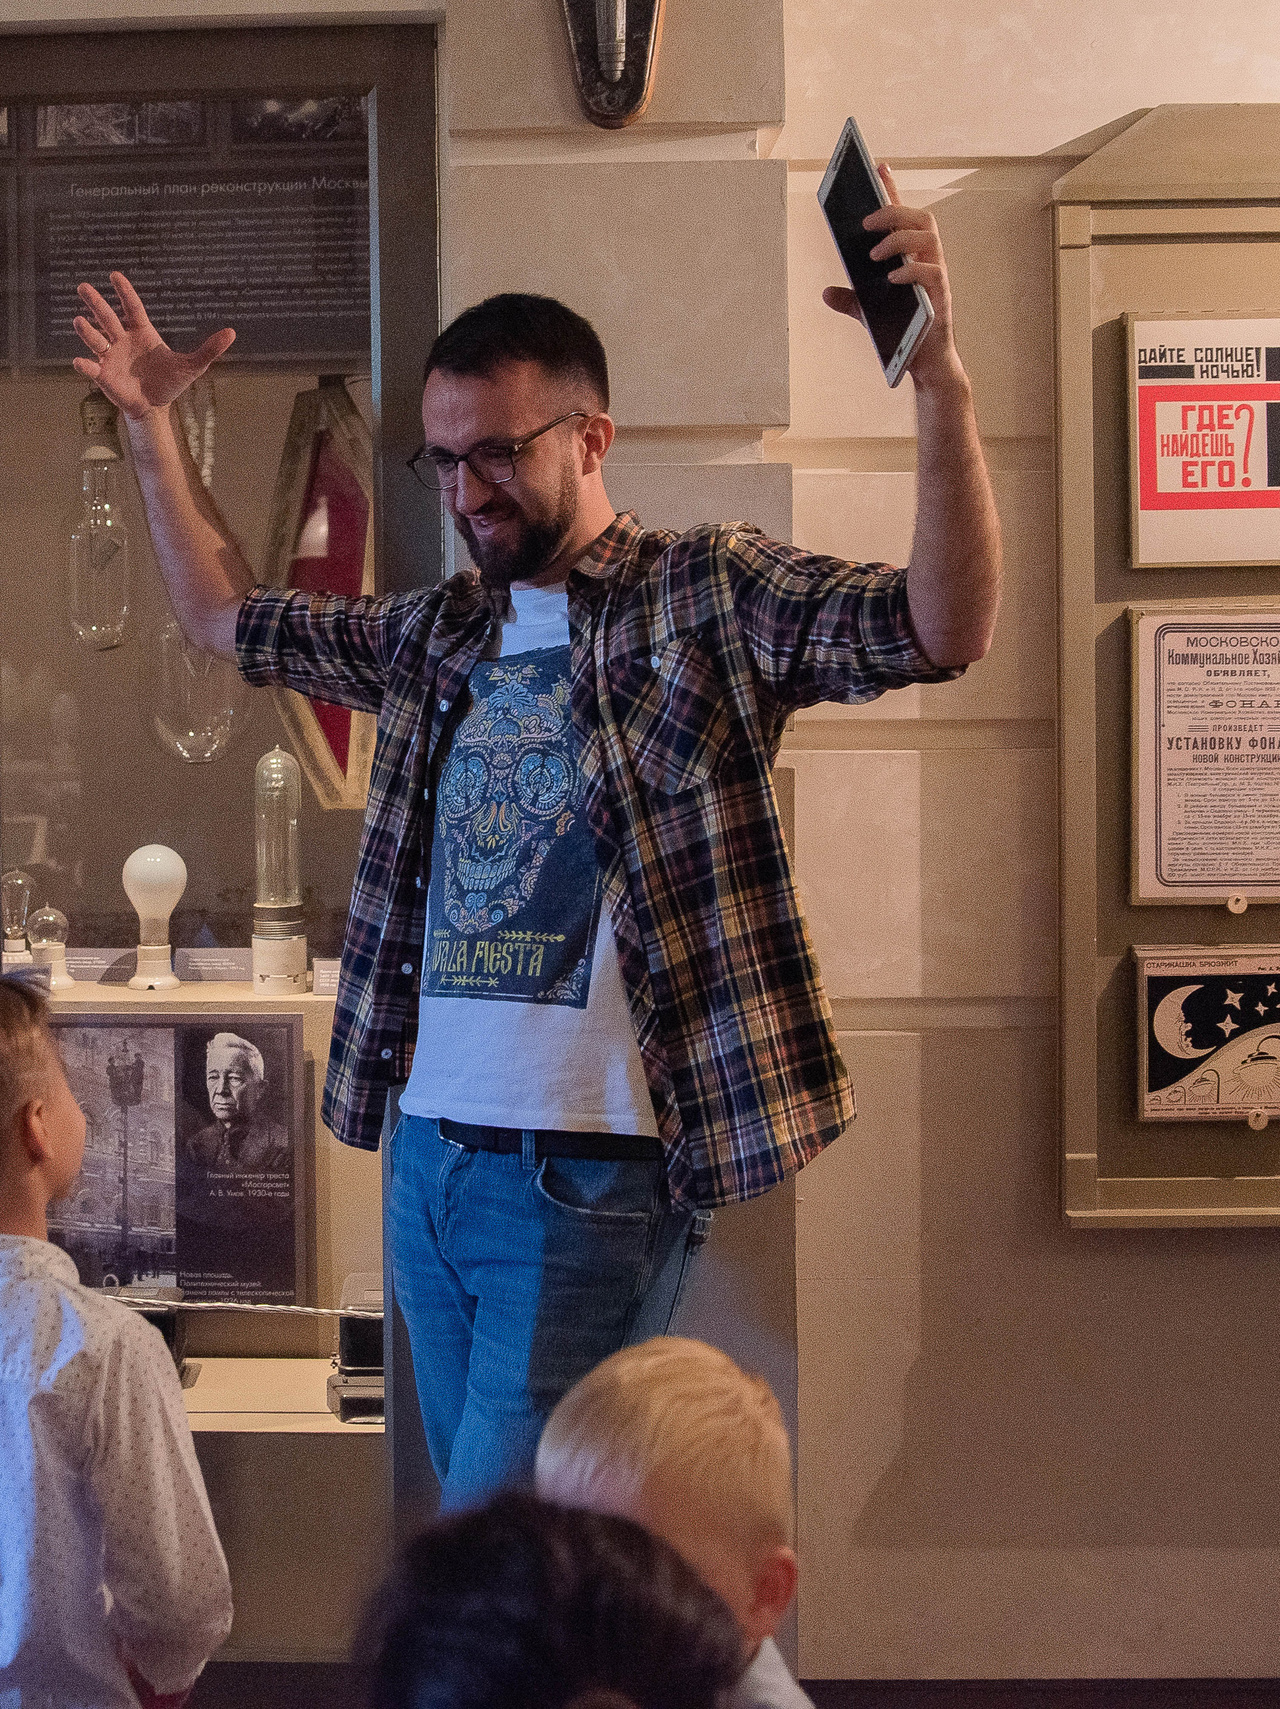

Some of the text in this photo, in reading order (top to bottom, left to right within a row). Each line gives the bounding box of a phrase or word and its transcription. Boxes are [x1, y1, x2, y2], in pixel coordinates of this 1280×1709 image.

[70, 183, 160, 199] Генеральный
[163, 184, 197, 195] план
[200, 180, 308, 197] реконструкции
[1138, 345, 1186, 365] ДАЙТЕ
[1181, 404, 1235, 432] ГДЕ
[1160, 430, 1235, 459] НАЙДЕШЬ
[1186, 636, 1279, 648] МОСКОВСКО
[1167, 648, 1250, 668] Коммунальное
[1212, 724, 1264, 733] ПРОИЗВЕДЕТ
[1166, 736, 1242, 751] УСТАНОВКУ
[1192, 753, 1219, 763] НОВОЙ
[471, 940, 546, 977] FIESTA
